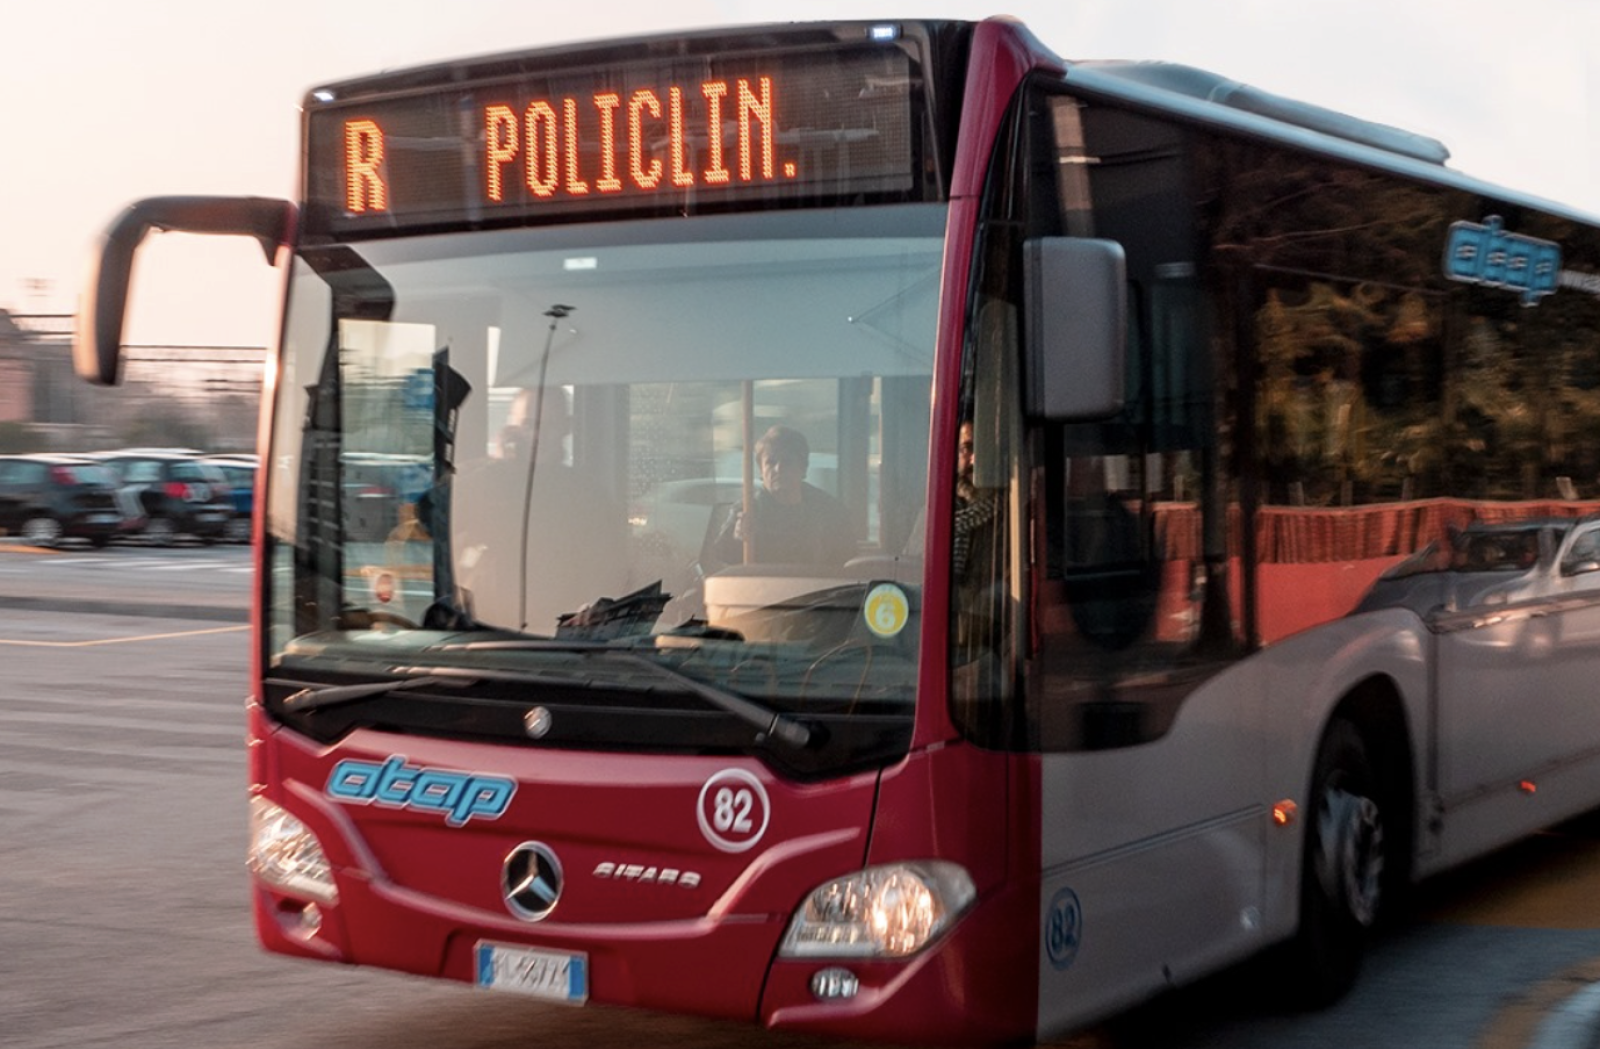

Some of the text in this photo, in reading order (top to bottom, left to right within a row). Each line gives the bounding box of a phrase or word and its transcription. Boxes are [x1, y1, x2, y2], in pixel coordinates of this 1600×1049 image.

[344, 76, 796, 213] R POLICLIN.
[326, 754, 517, 827] atap
[713, 787, 753, 833] 82
